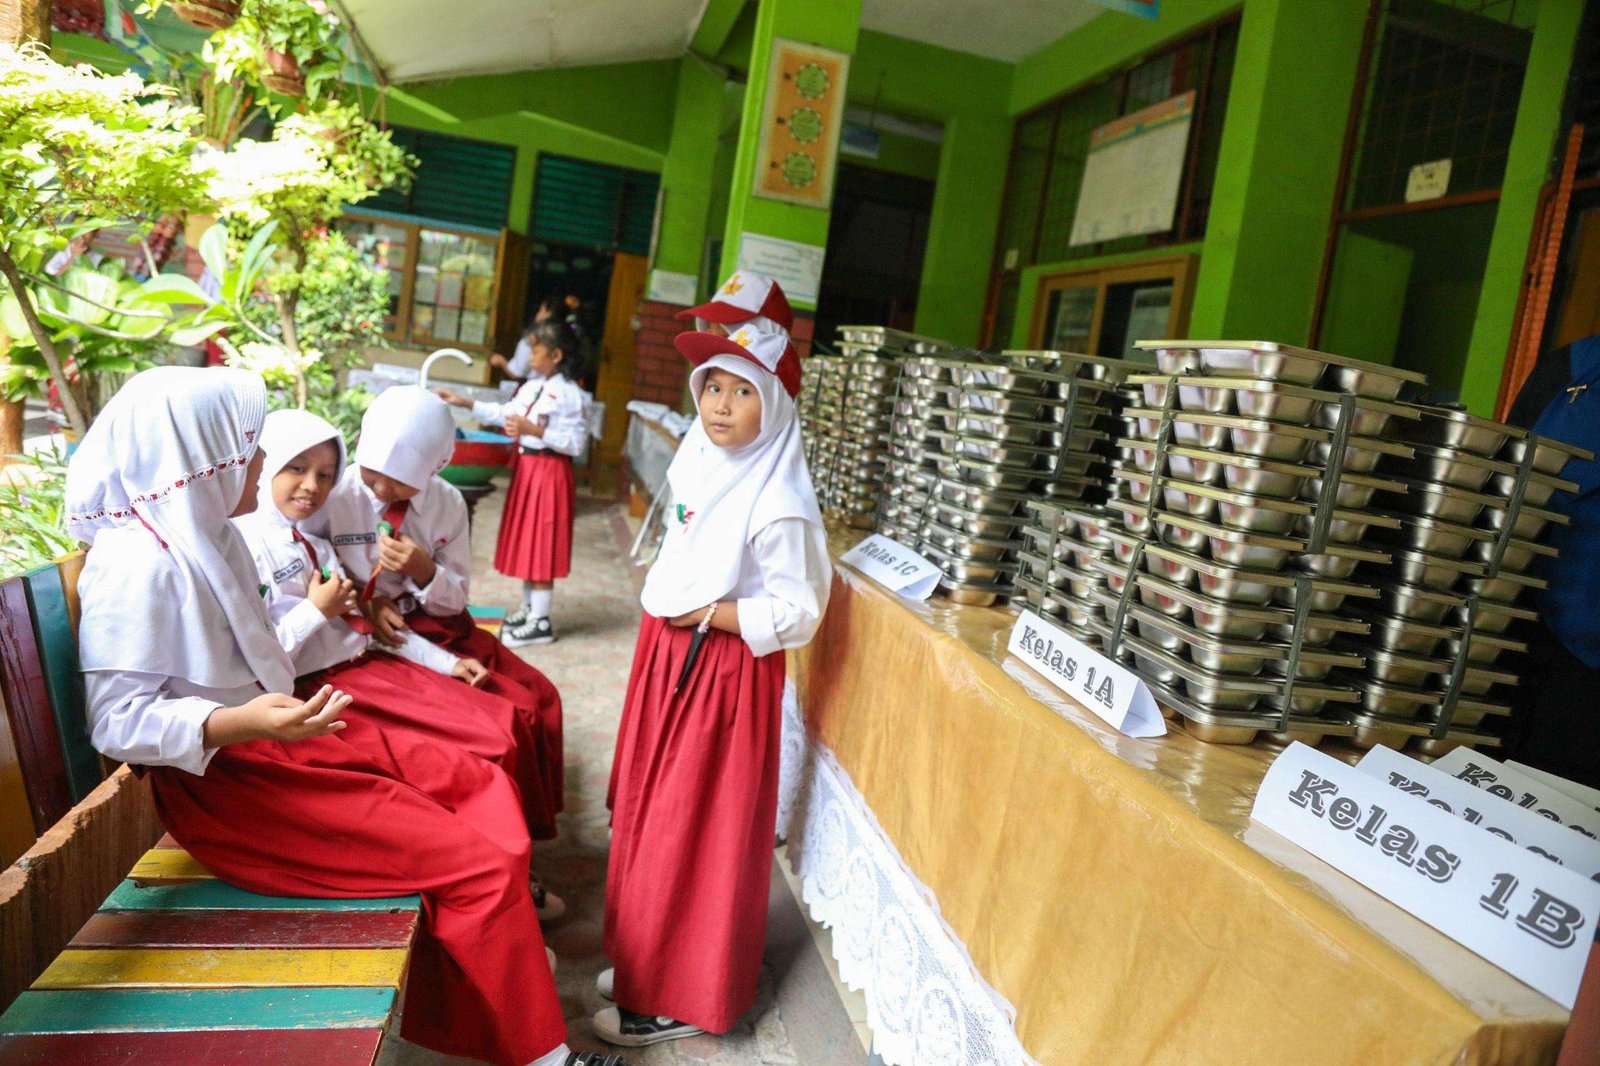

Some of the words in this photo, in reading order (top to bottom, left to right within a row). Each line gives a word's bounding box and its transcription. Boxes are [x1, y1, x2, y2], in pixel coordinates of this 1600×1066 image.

[859, 541, 898, 566] Kelas
[893, 560, 920, 577] 1C
[1019, 625, 1078, 681] Kelas
[1084, 666, 1115, 709] 1A
[1288, 769, 1461, 884] Kelas
[1479, 872, 1586, 949] 1B
